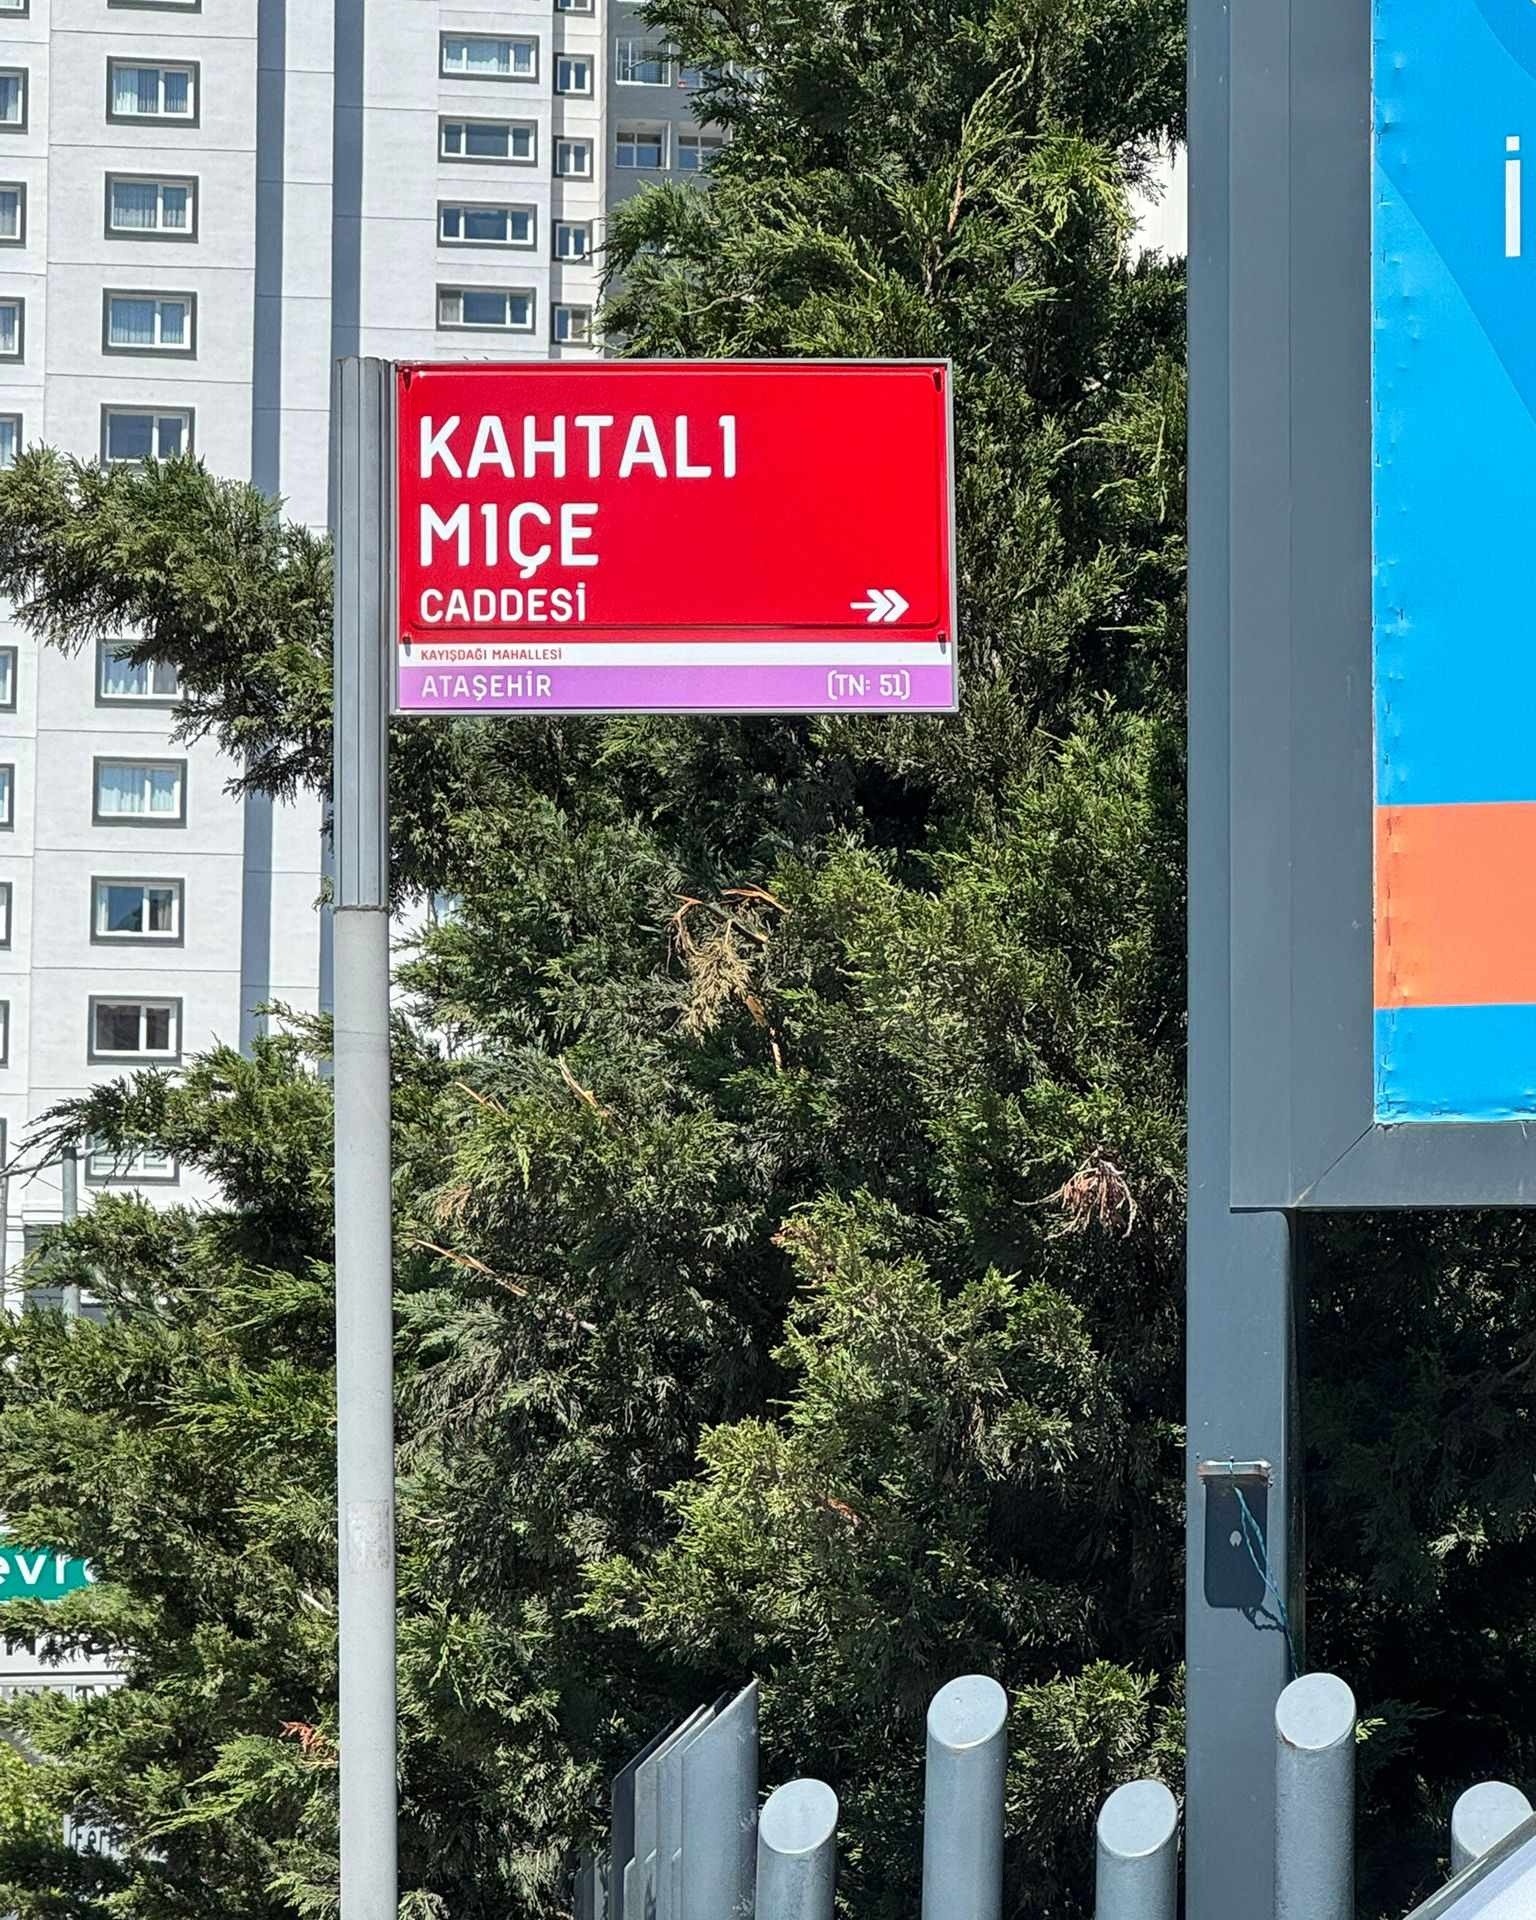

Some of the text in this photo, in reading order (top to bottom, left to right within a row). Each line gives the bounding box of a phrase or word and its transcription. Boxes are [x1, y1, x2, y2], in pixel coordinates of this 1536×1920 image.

[420, 414, 737, 479] KAHTALI
[420, 502, 599, 579] MIÇE
[420, 582, 586, 623] CADDESİ
[420, 647, 562, 663] KAYIŞDAĞI MAHALLESİ
[421, 670, 552, 701] ATAŞEHİR
[827, 669, 911, 700] (TN: 51)
